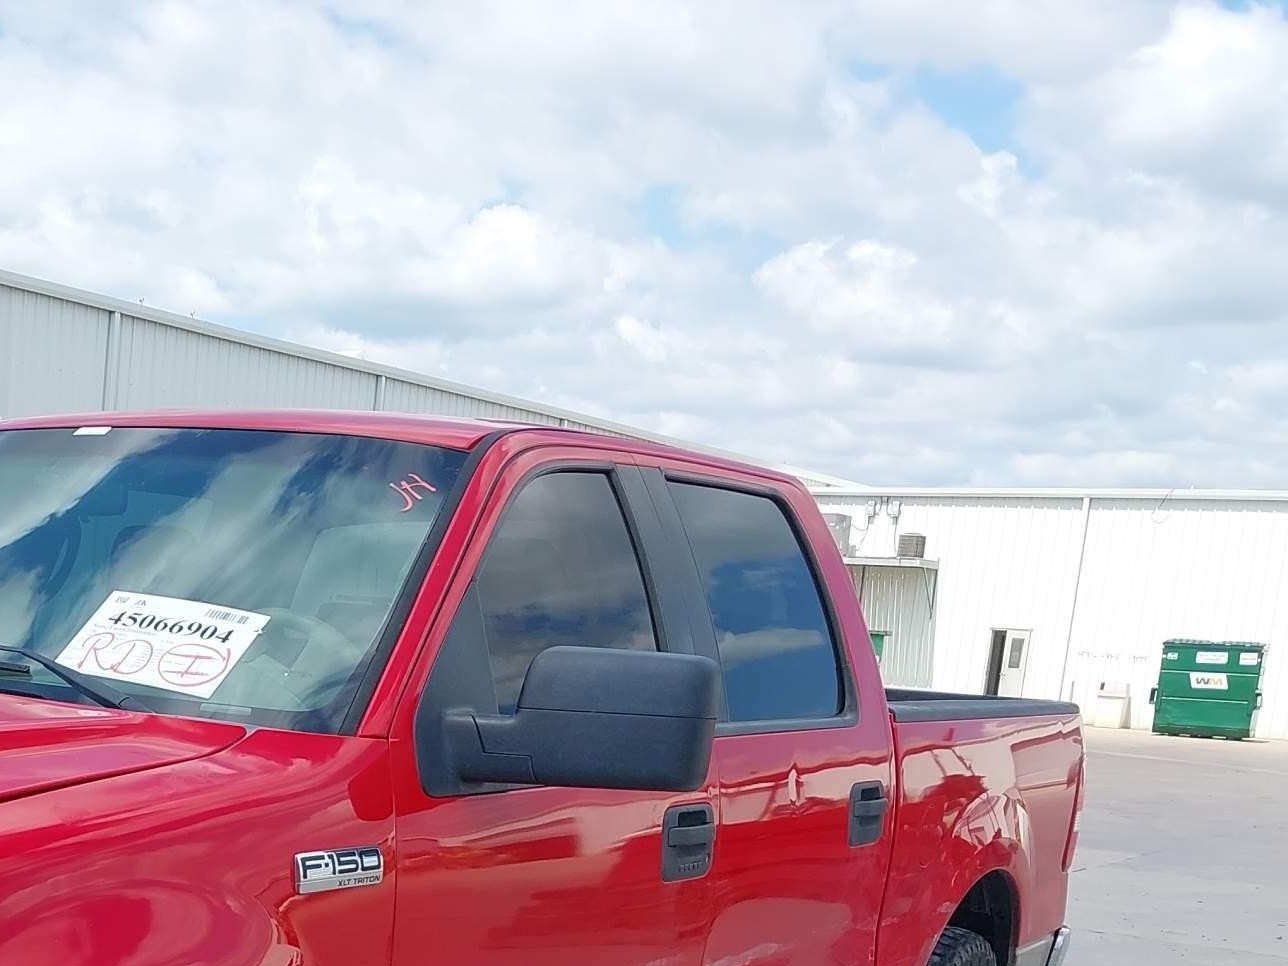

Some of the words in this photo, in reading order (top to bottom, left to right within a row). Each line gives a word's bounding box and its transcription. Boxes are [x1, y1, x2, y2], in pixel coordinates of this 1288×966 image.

[108, 611, 235, 644] 45066904
[77, 632, 154, 675] RD
[337, 879, 352, 887] XLT
[353, 875, 381, 885] TRITON
